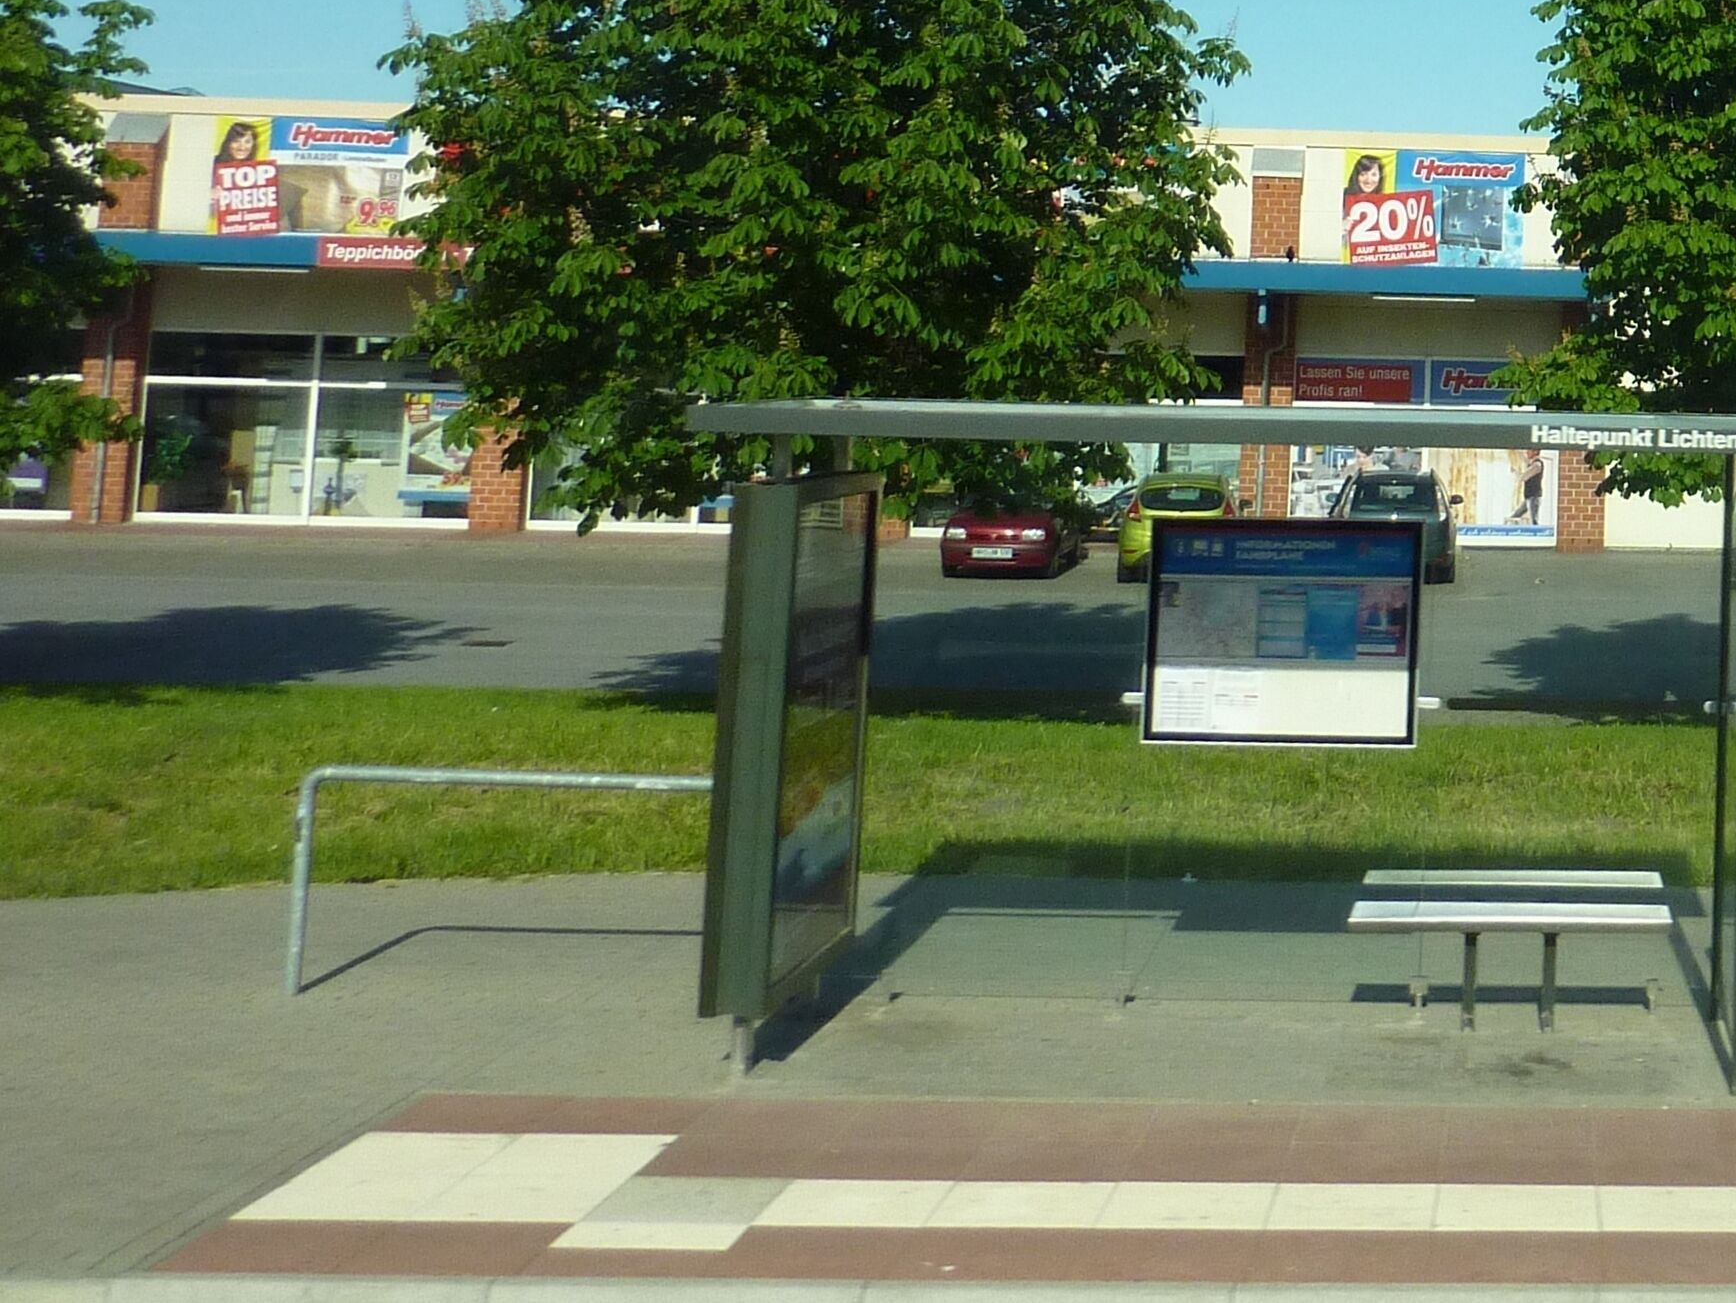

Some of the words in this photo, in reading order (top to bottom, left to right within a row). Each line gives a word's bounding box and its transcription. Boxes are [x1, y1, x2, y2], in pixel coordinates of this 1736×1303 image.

[289, 122, 398, 148] Hammer
[219, 165, 276, 189] TOP
[1414, 157, 1514, 183] Hammer
[220, 187, 277, 210] PREISE
[1350, 195, 1434, 243] 20%
[1352, 249, 1435, 263] SCHUTZANLAGEN
[1356, 245, 1376, 254] AUF
[1300, 365, 1342, 378] Lassen
[1346, 366, 1364, 379] Sie
[1369, 369, 1410, 381] unsere
[1299, 383, 1334, 396] Profis
[1339, 383, 1363, 396] ran!
[1531, 425, 1653, 448] Haltepunkt
